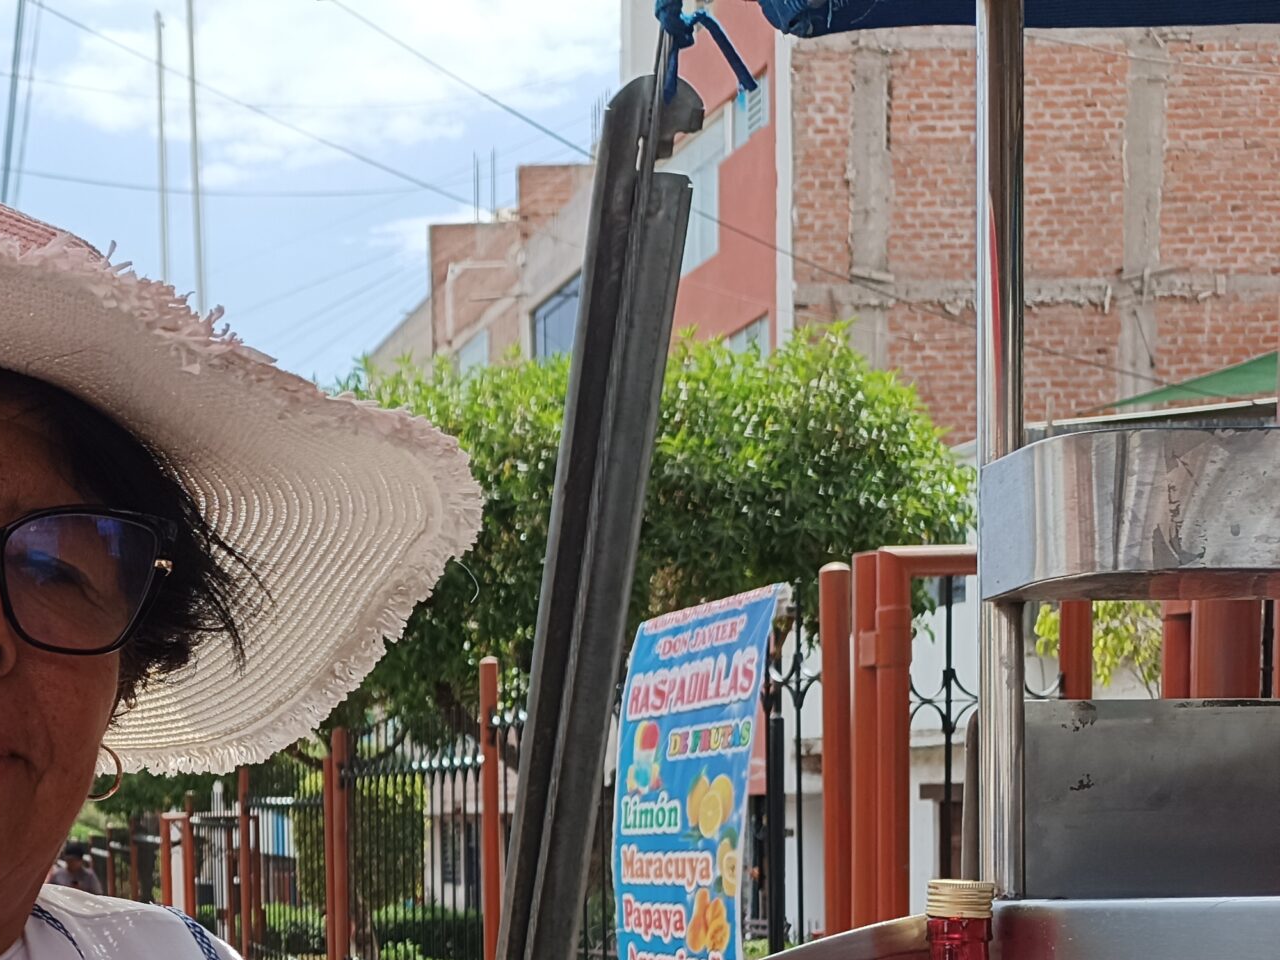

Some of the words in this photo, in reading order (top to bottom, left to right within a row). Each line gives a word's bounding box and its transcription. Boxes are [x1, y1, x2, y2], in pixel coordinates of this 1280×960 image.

[628, 653, 756, 718] RASPADILLAS
[668, 730, 690, 757] DE
[689, 718, 752, 754] FRUTAS
[622, 796, 680, 831] Limón
[621, 847, 711, 889] Maracuya
[622, 897, 685, 939] Papaya
